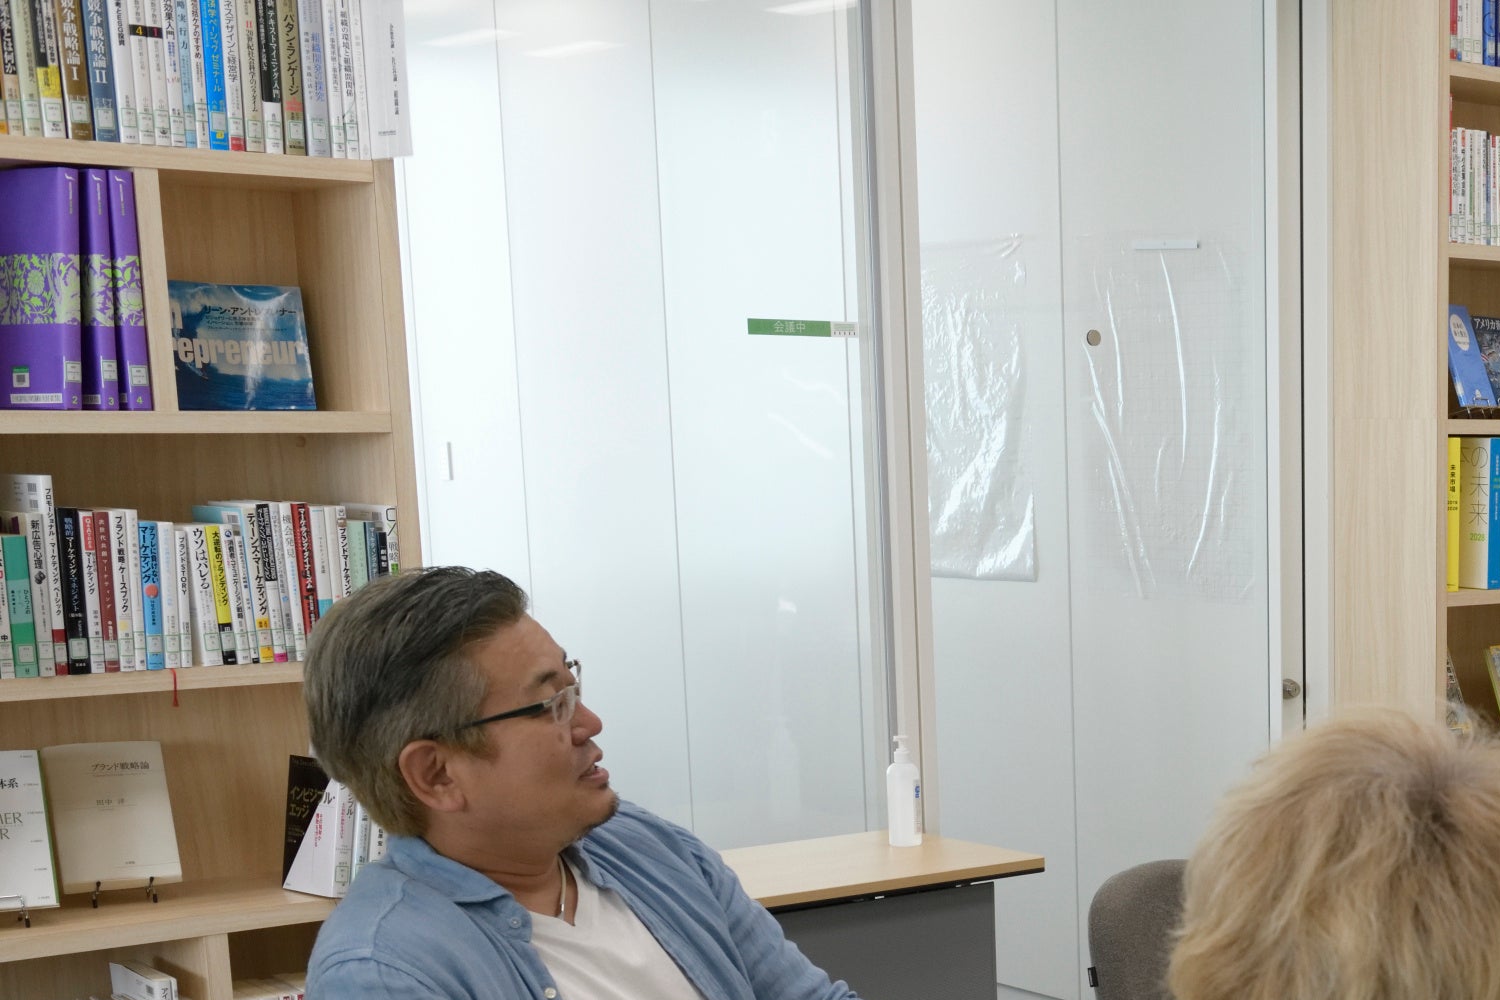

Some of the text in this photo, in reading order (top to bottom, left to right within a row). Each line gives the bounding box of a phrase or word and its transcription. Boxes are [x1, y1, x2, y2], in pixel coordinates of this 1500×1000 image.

[774, 320, 806, 333] 会議中
[72, 396, 78, 404] 2
[108, 397, 115, 406] 3
[136, 396, 143, 404] 4
[139, 526, 151, 584] マーケティング
[91, 760, 150, 771] ブランド戦略論
